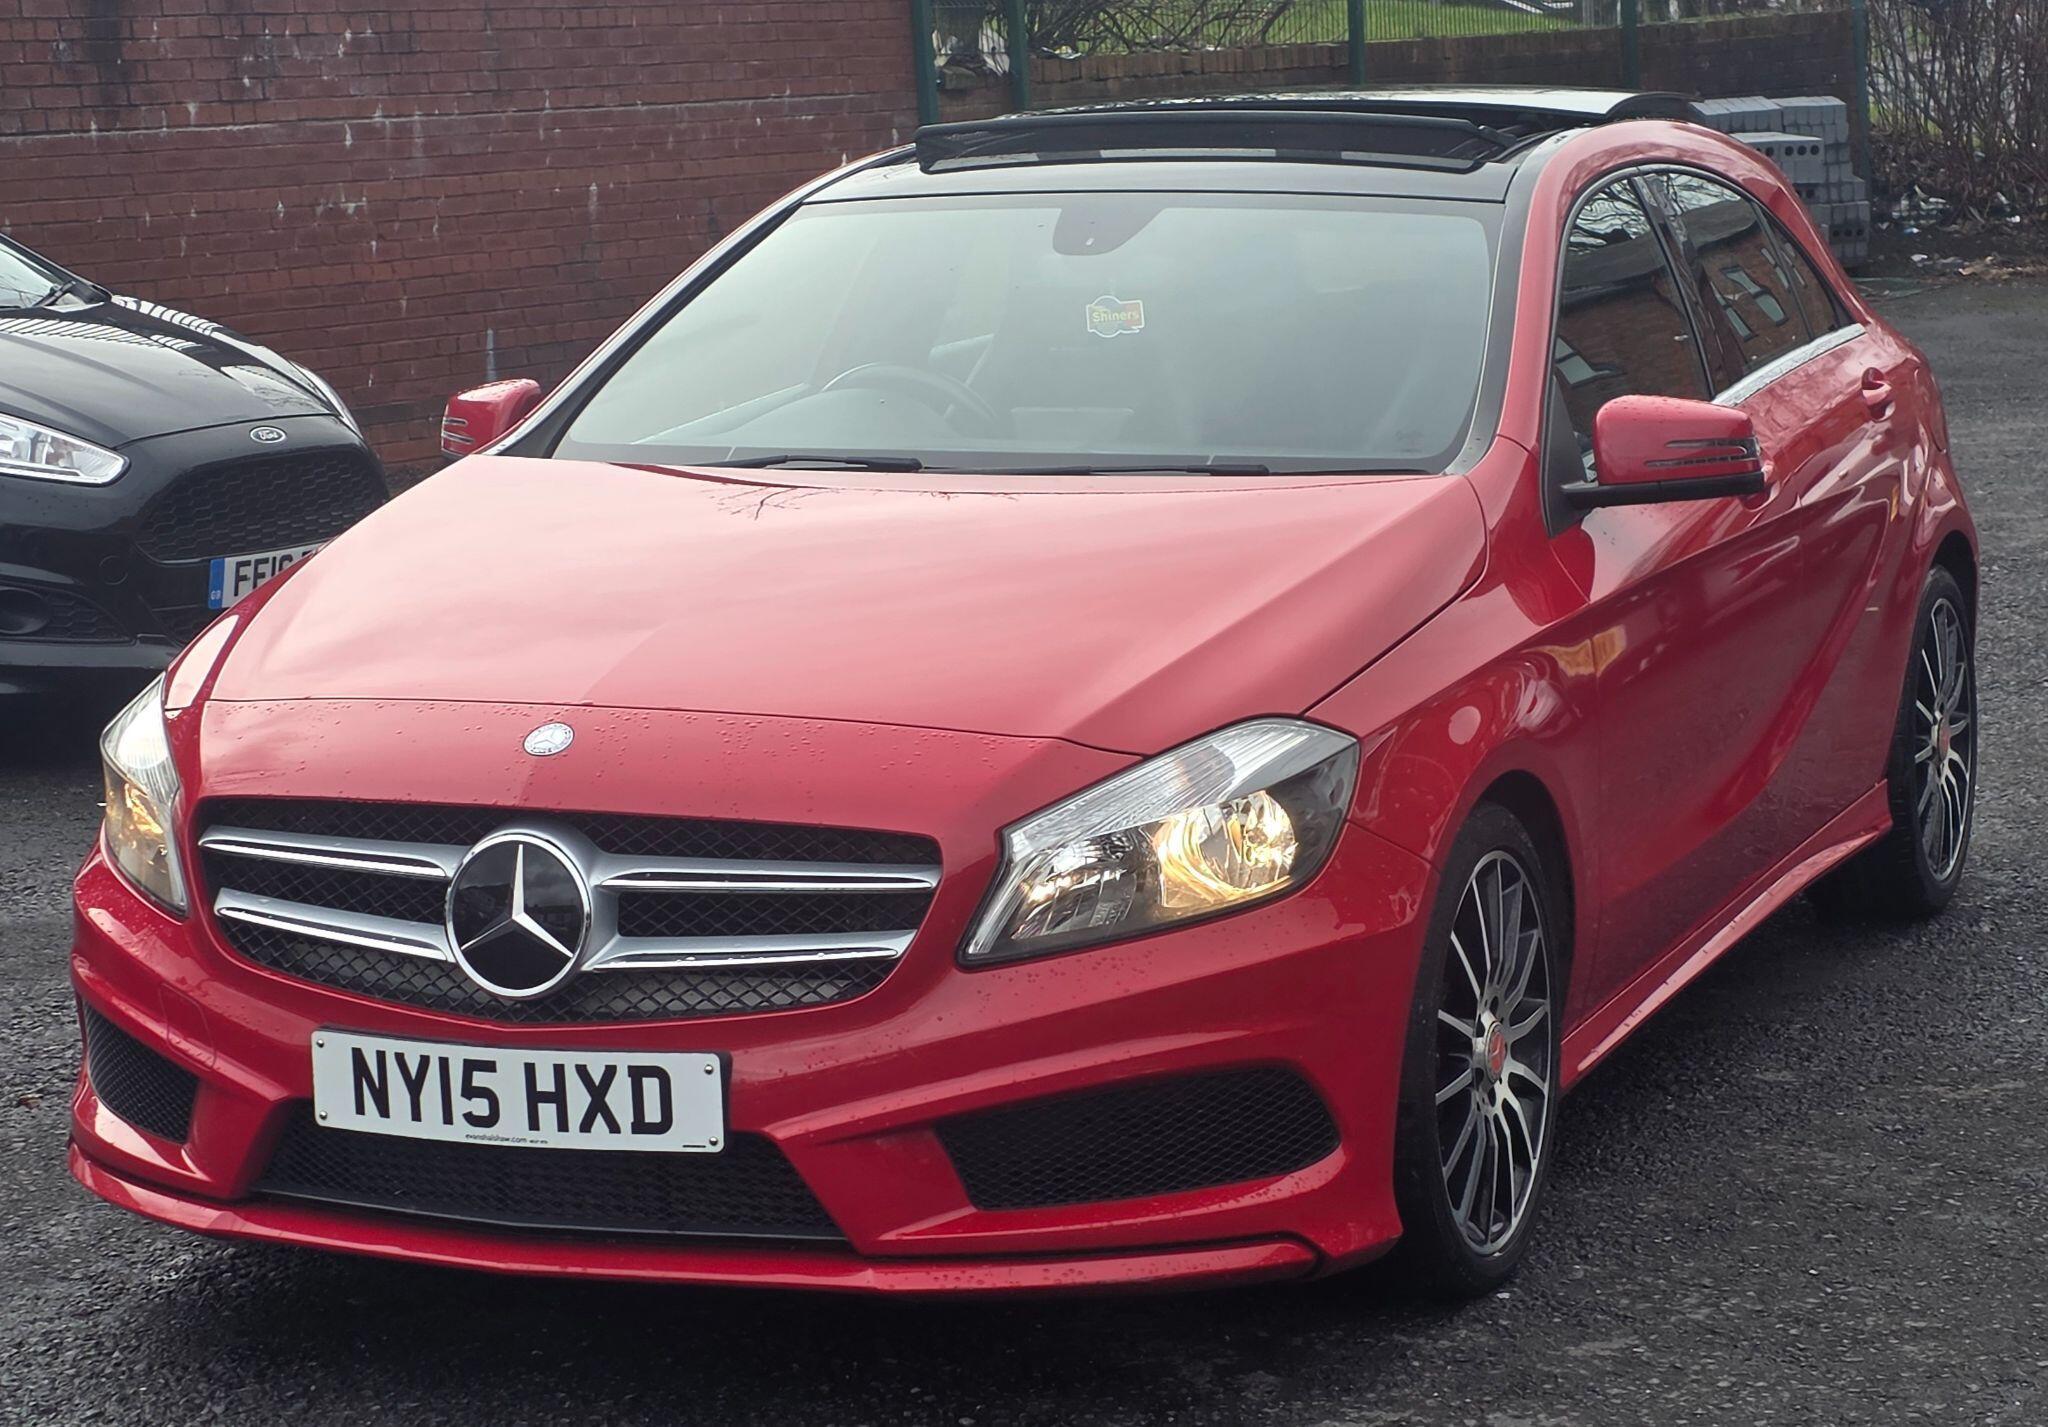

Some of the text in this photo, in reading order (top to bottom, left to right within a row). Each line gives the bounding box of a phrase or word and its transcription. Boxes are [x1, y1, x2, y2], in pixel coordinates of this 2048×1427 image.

[1092, 311, 1139, 322] Shiners
[351, 1046, 674, 1135] NY15 HXD
